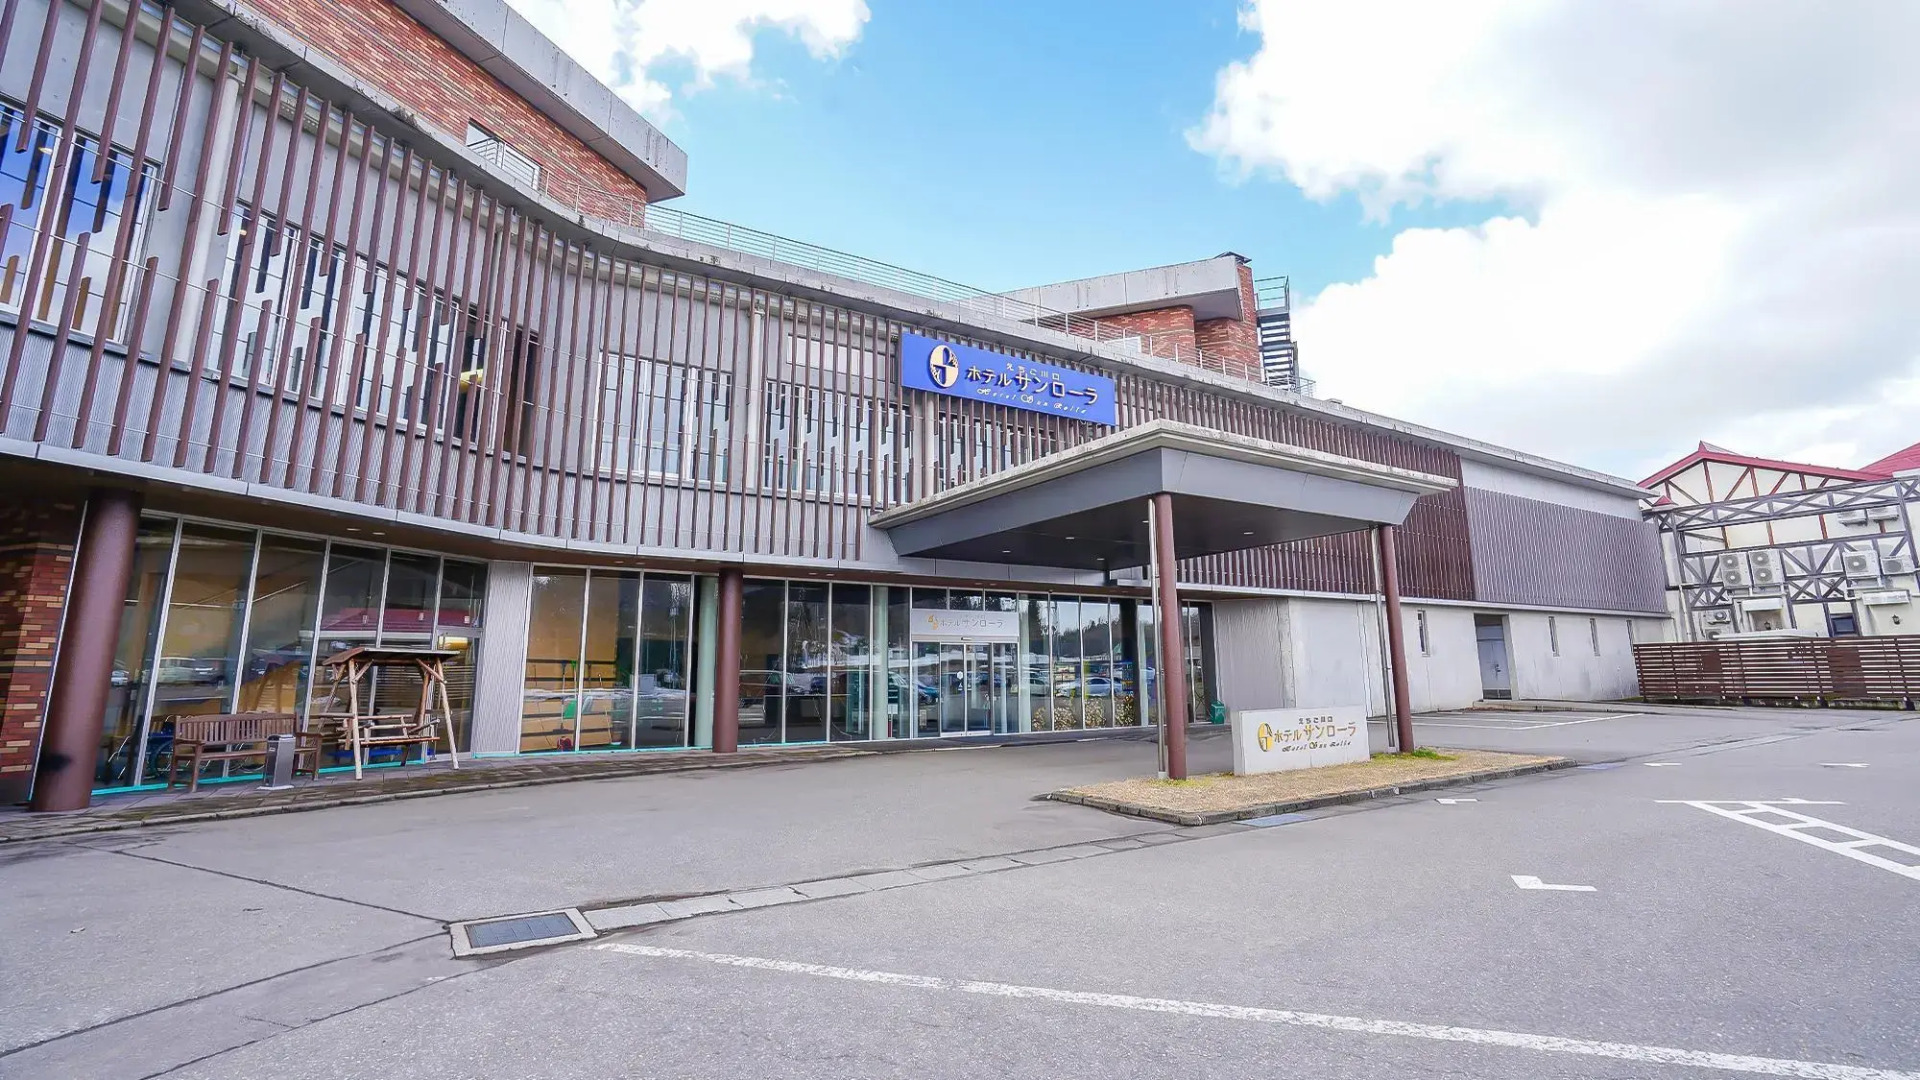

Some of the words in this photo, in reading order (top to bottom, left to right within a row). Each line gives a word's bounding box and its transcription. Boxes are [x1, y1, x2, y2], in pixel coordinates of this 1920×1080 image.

[966, 366, 1098, 405] ホテルサンローラ
[940, 618, 1004, 628] ホテルサンローラ
[1274, 721, 1356, 743] ホテルサンローラ
